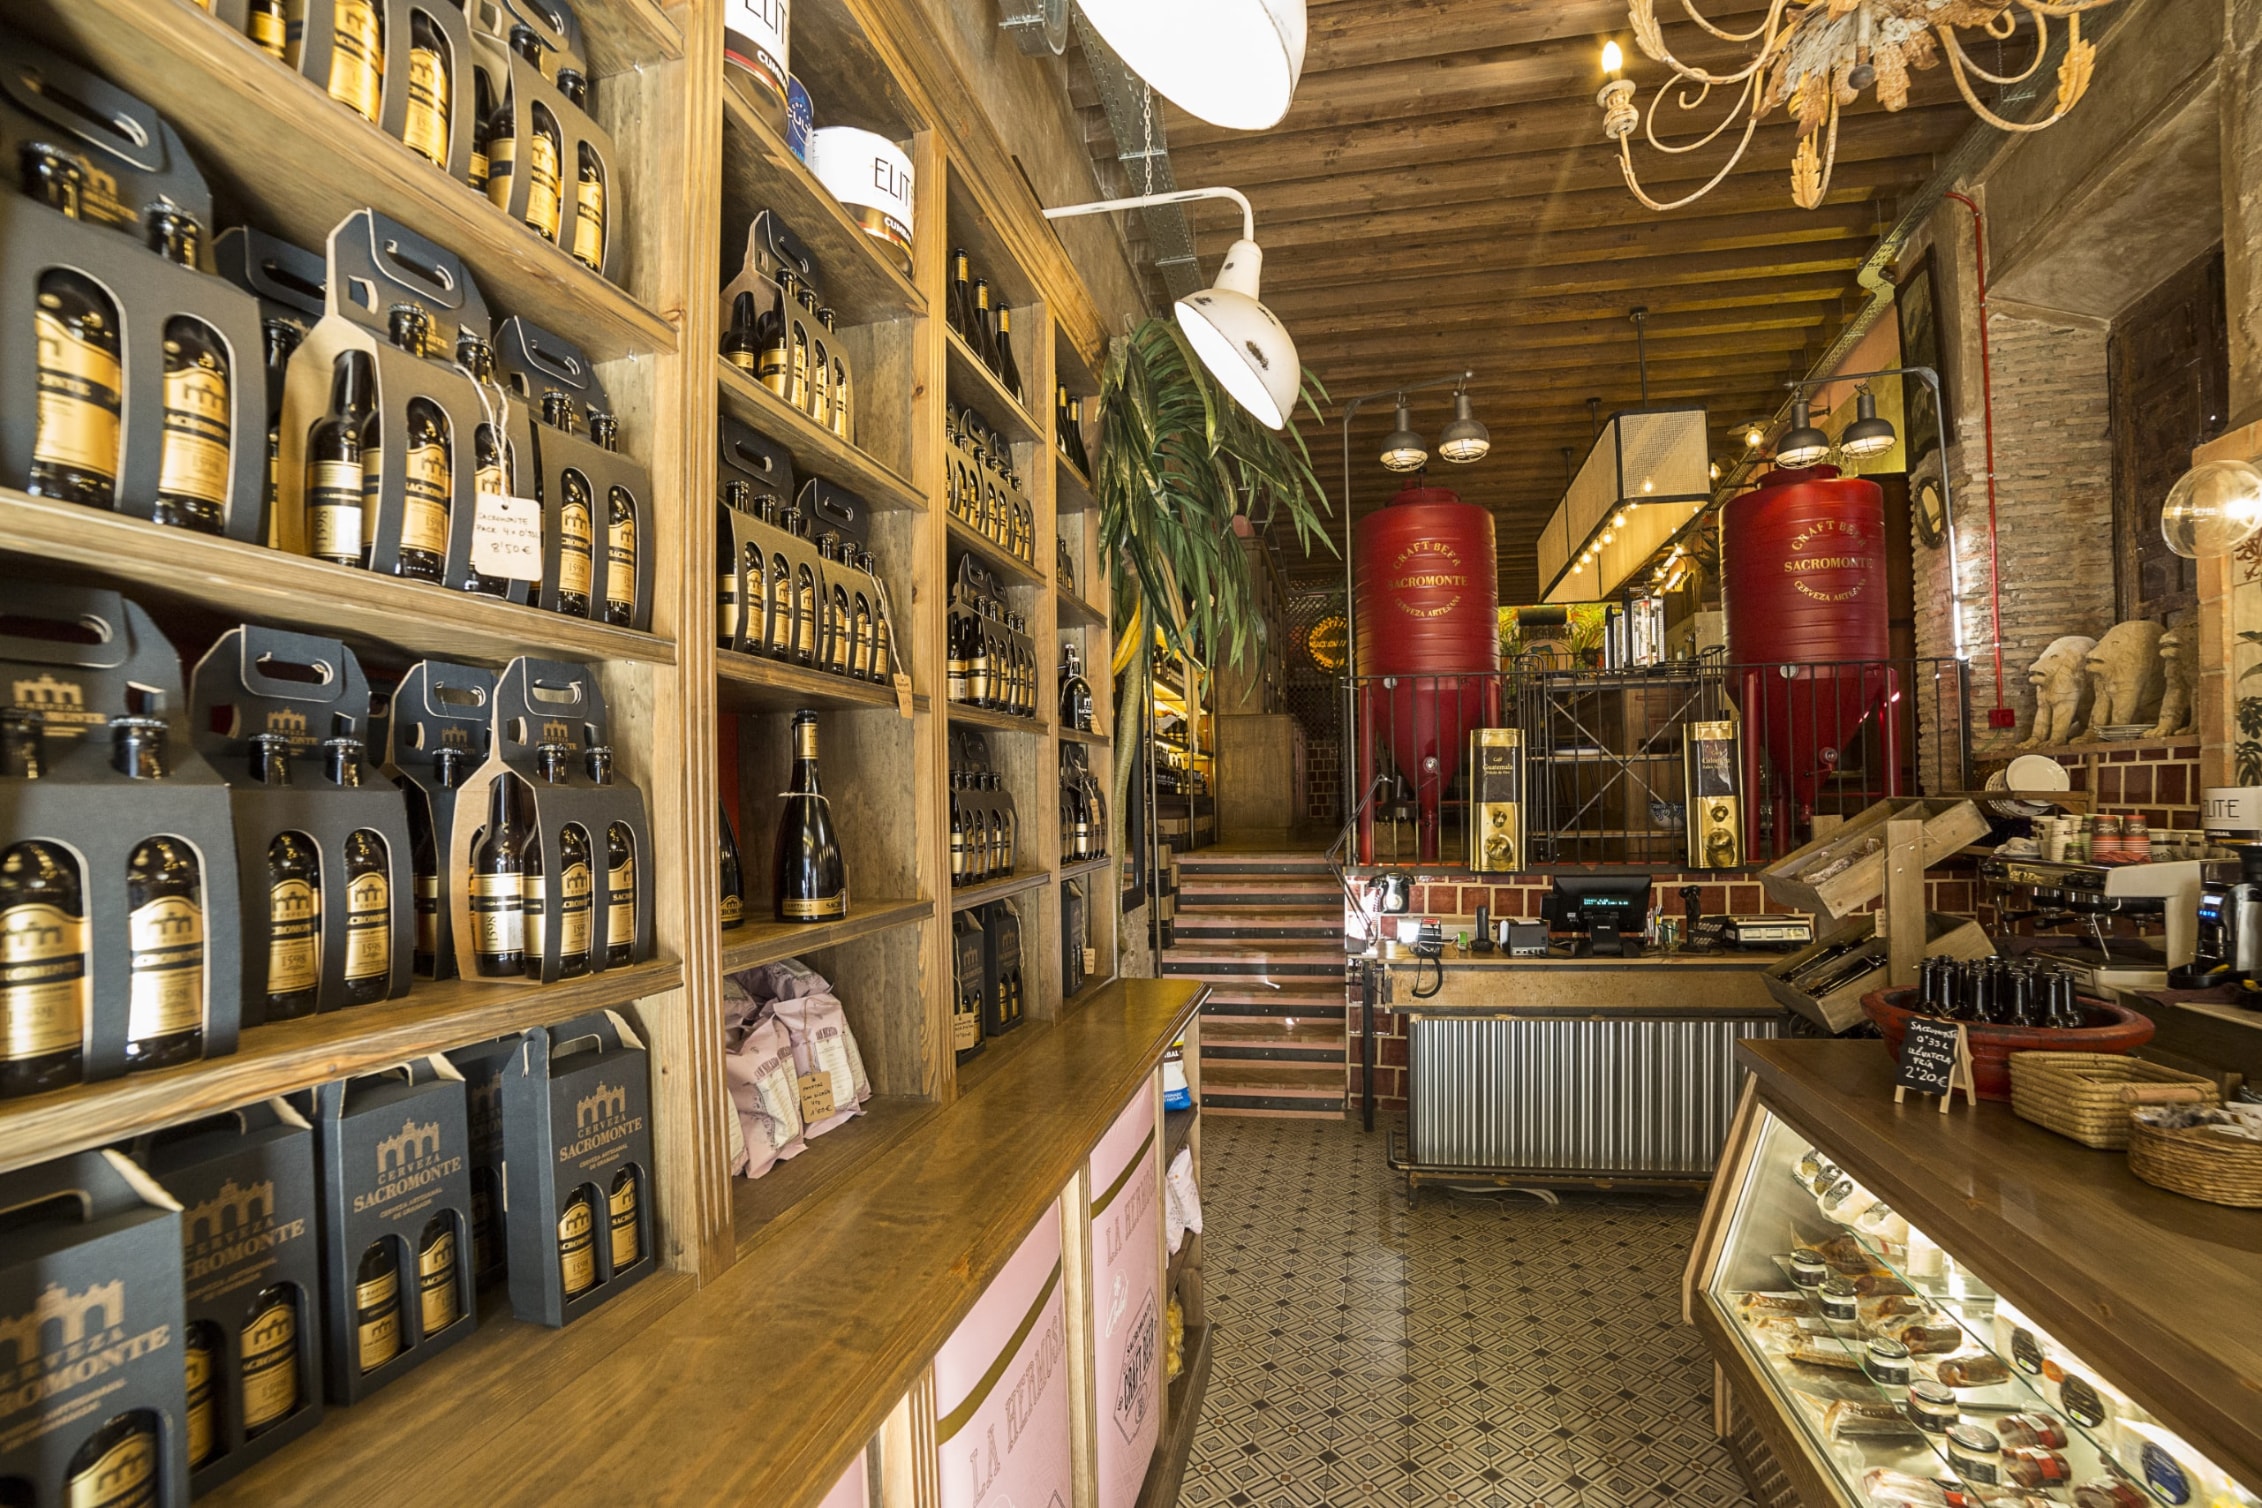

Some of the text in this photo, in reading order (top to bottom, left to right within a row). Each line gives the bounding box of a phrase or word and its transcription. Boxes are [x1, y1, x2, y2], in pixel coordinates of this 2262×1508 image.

[1793, 519, 1835, 551] CRAFT
[1784, 556, 1873, 573] SACROMONTE
[1387, 575, 1469, 592] SACROMONTE
[1793, 580, 1831, 602] CERVEZA
[559, 1116, 643, 1162] SACROMONTE
[576, 1111, 626, 1139] CERVEZA
[377, 1153, 441, 1186] CERVEZA
[353, 1156, 462, 1214] SACROMONTE
